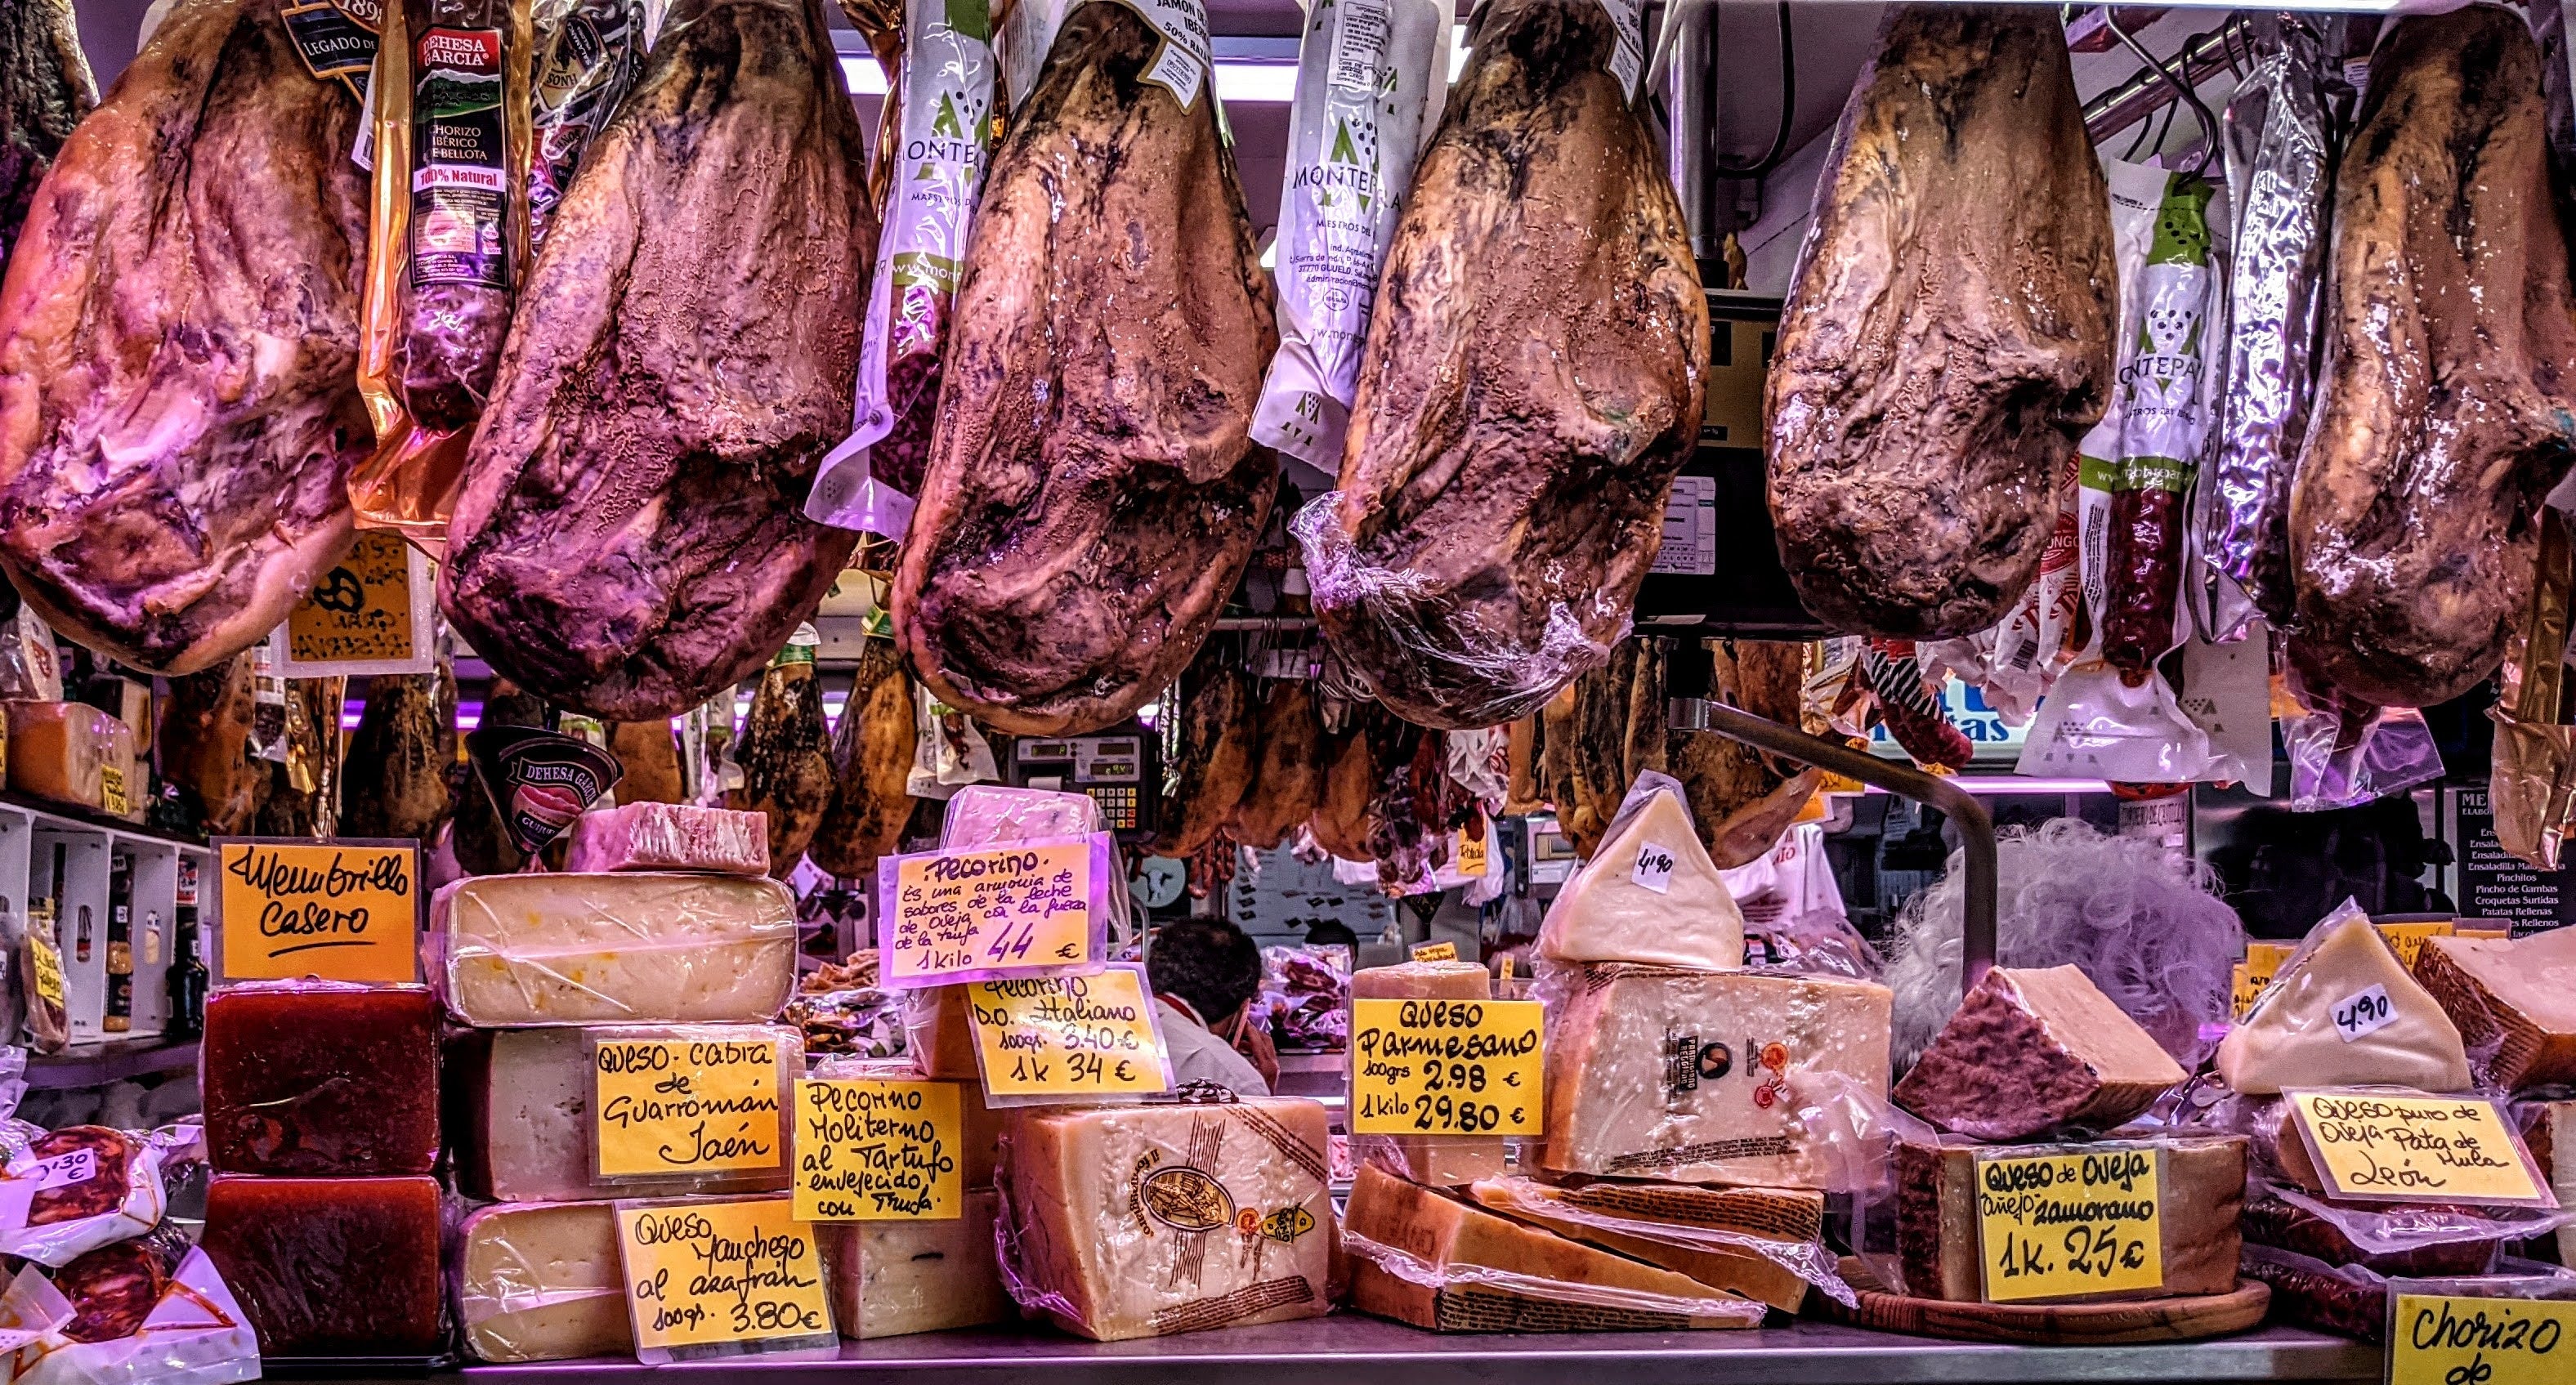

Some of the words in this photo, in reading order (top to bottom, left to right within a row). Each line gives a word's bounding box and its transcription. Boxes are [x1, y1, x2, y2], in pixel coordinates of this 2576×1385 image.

[303, 37, 360, 56] LEGADO
[364, 40, 376, 50] DE
[423, 35, 486, 55] DEHESA
[1164, 21, 1187, 44] 50%
[428, 125, 481, 137] CHORIZO
[432, 136, 478, 148] IBÉRICO
[441, 149, 488, 160] BELLOTA
[421, 168, 449, 185] 100%
[452, 170, 498, 186] Natural
[525, 765, 575, 782] DEHESA
[228, 846, 408, 898] Membrillo
[2468, 862, 2515, 871] Ensaladilla
[2497, 873, 2537, 882] Pinchitos
[932, 885, 961, 899] una
[1053, 869, 1073, 883] de
[2475, 885, 2506, 894] Pincho
[2507, 885, 2519, 893] de
[2521, 885, 2558, 894] Gambas
[899, 919, 917, 934] de
[984, 906, 1009, 919] con
[1018, 899, 1040, 914] la
[1044, 898, 1087, 918] fuerza
[904, 900, 957, 918] sabores
[968, 895, 987, 909] de
[995, 890, 1016, 905] la
[1025, 884, 1072, 900] leche
[2475, 897, 2520, 906] Croquetas
[2522, 896, 2559, 905] Surtidas
[2516, 908, 2552, 916] Rellenas
[2521, 918, 2559, 927] Rellenos
[895, 936, 913, 949] de
[917, 931, 932, 946] la
[987, 922, 1034, 963] 44
[1055, 943, 1080, 959] €
[974, 1003, 1014, 1026] D.O.
[1029, 997, 1136, 1022] Italiano
[1357, 1027, 1537, 1060] Parmesano
[1067, 1052, 1102, 1083] 34
[1114, 1059, 1137, 1082] €
[1362, 1060, 1411, 1085] 100grs
[1423, 1059, 1487, 1093] 2.98
[1502, 1071, 1521, 1088] €
[655, 1072, 692, 1094] de
[806, 1082, 922, 1112] Pecorino
[604, 1079, 779, 1128] Guarromán
[1414, 1094, 1500, 1132] 29.80
[1509, 1106, 1525, 1124] €
[2395, 1106, 2449, 1126] puro
[2453, 1105, 2481, 1121] de
[808, 1110, 934, 1143] Moliterno
[2319, 1119, 2384, 1148] Oveja
[2385, 1127, 2451, 1151] Pata
[2453, 1131, 2481, 1152] de
[659, 1120, 770, 1164] Jaén
[68, 1167, 85, 1180] €
[803, 1144, 834, 1172] al
[851, 1140, 954, 1183] Tartufo
[2057, 1163, 2076, 1183] de
[2082, 1151, 2149, 1192] Oveja
[2350, 1150, 2447, 1188] León
[2436, 1150, 2510, 1168] Mula
[818, 1200, 855, 1217] con
[636, 1213, 712, 1245] Queso
[691, 1226, 804, 1276] Manchego
[637, 1267, 669, 1301] al
[2413, 1301, 2560, 1354] Chorizo
[2445, 1352, 2491, 1385] de
